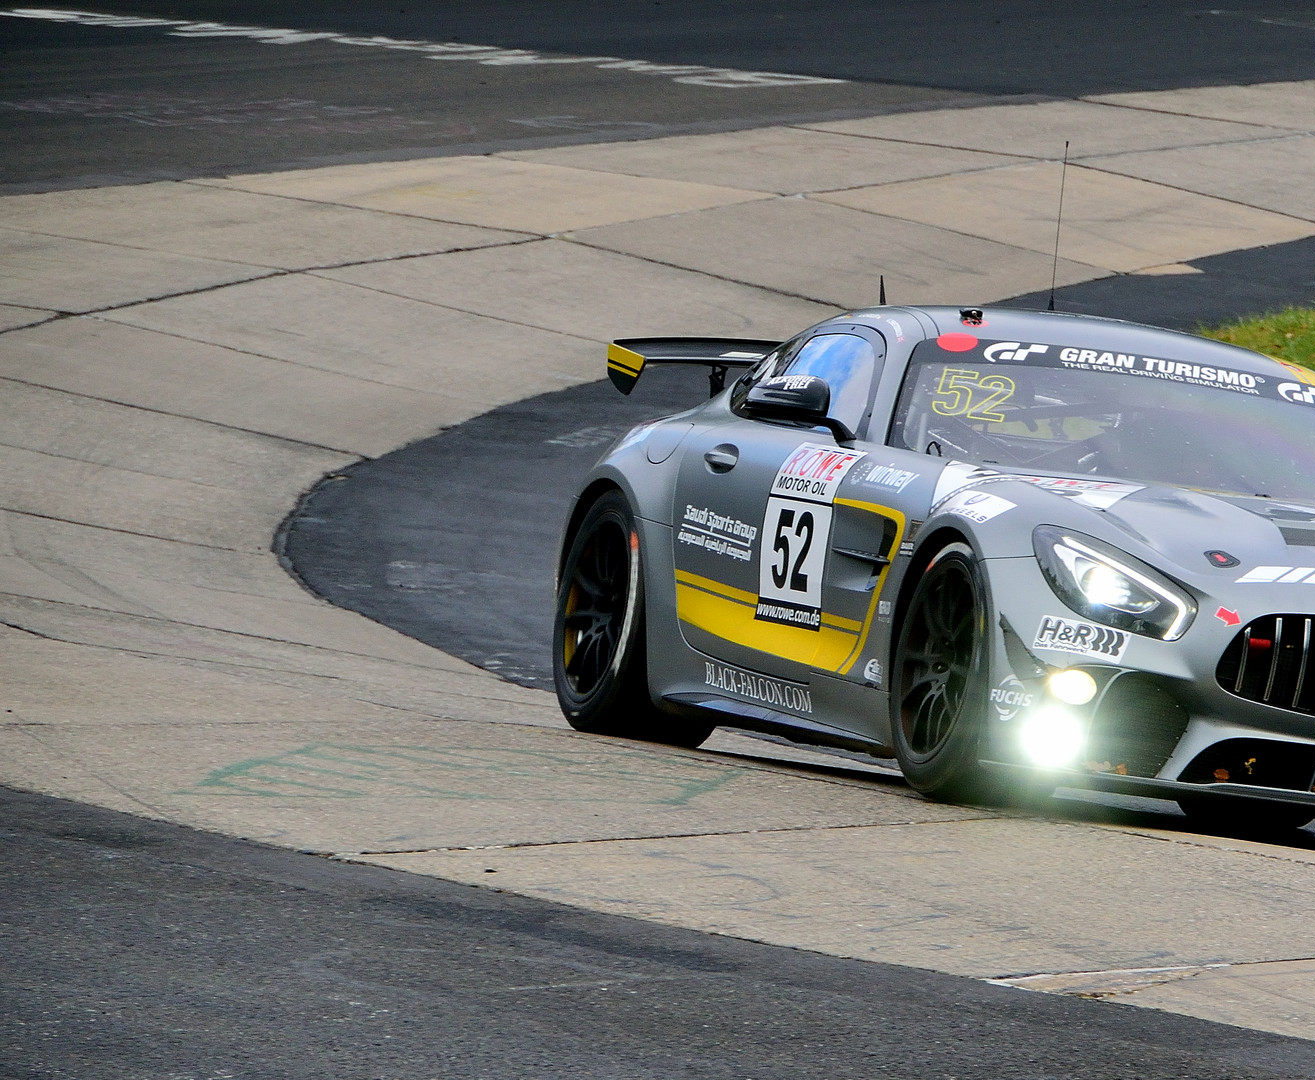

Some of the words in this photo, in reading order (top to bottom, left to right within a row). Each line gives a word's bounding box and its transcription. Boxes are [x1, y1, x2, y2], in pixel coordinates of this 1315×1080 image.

[1059, 347, 1135, 368] GRAN
[1061, 361, 1090, 370] THE
[1092, 365, 1128, 375] REAL
[1130, 369, 1185, 382] DRIVING
[1186, 377, 1260, 395] SIMULATOR
[931, 368, 1016, 423] 52
[782, 449, 853, 482] ROWE
[865, 462, 920, 494] winway
[776, 475, 811, 493] MOTOR
[811, 481, 828, 496] OIL
[684, 504, 709, 525] Saudi
[707, 511, 735, 533] Sports
[733, 520, 758, 547] Group
[771, 508, 815, 593] 52
[756, 602, 821, 627] www.rowe.com.de
[1038, 617, 1093, 649] H&R
[704, 661, 813, 714] BLACK-FALCON.COM
[990, 688, 1034, 707] FUCHS
